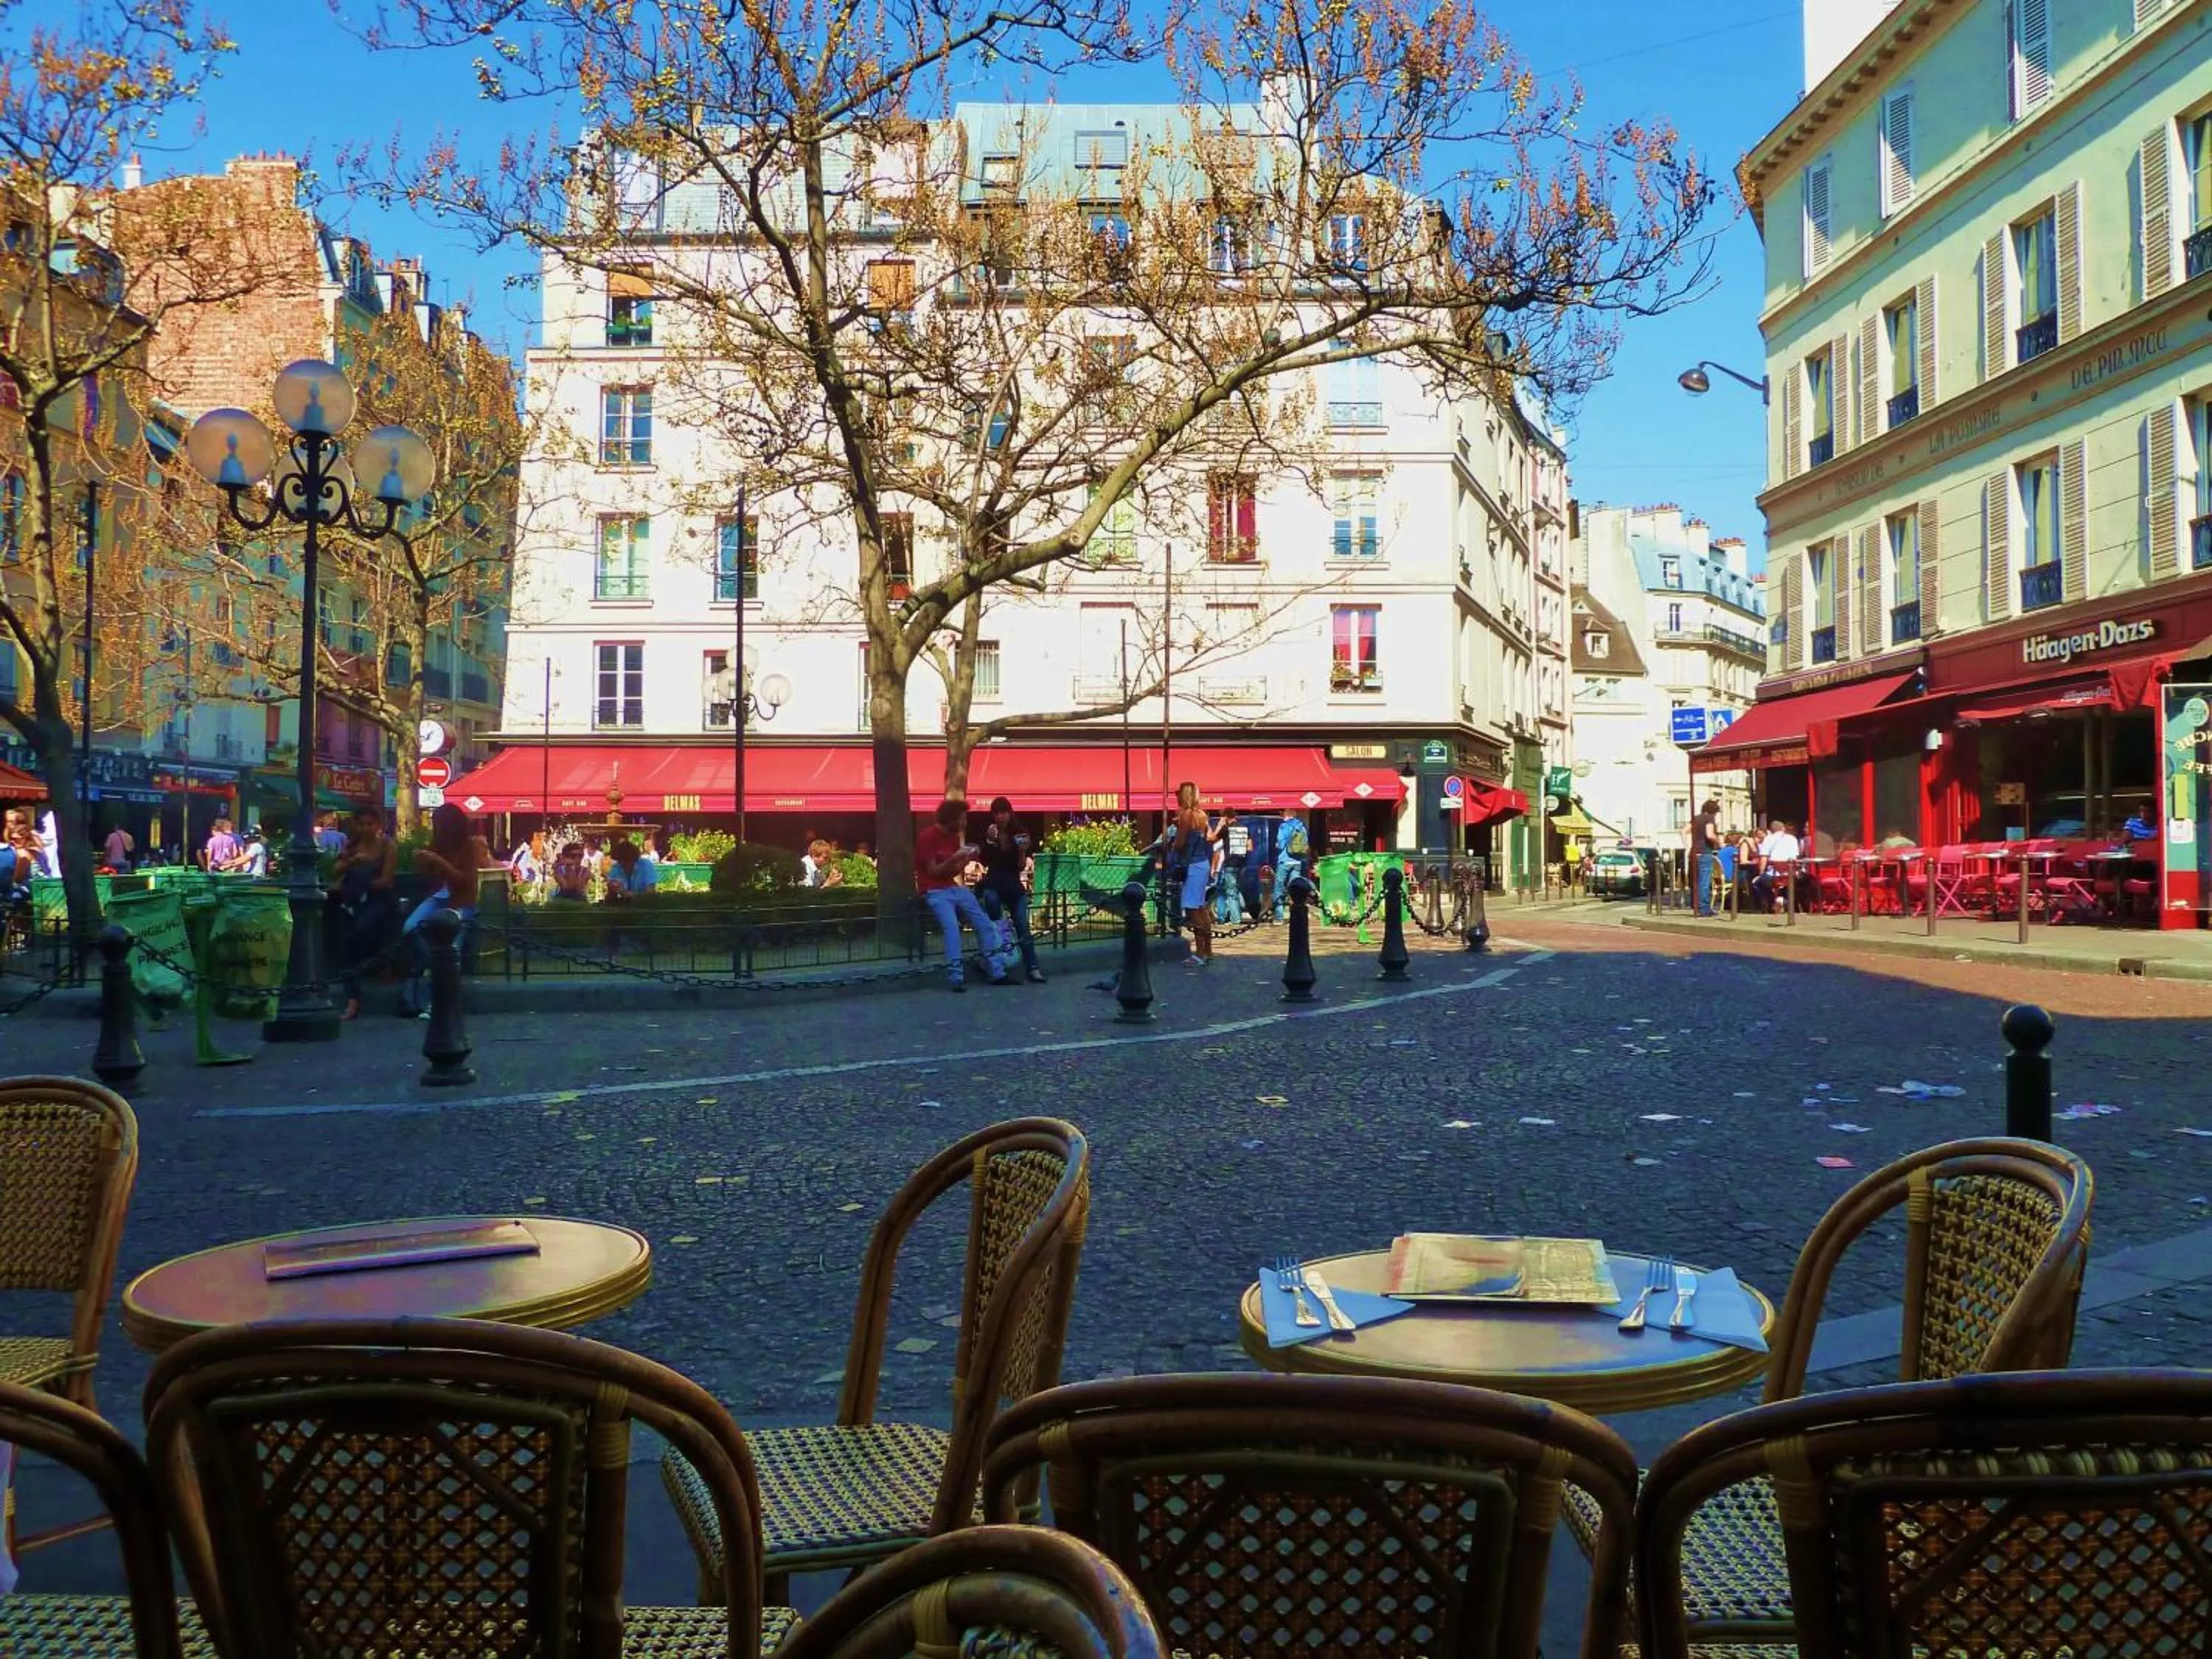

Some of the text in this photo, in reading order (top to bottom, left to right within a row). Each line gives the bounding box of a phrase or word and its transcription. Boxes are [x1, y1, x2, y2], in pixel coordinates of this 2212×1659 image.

[2023, 619, 2155, 664] Häagen-Dazs
[1344, 746, 1373, 757] SALON
[664, 795, 700, 811] DELMAS
[1081, 793, 1119, 810] DELMAS
